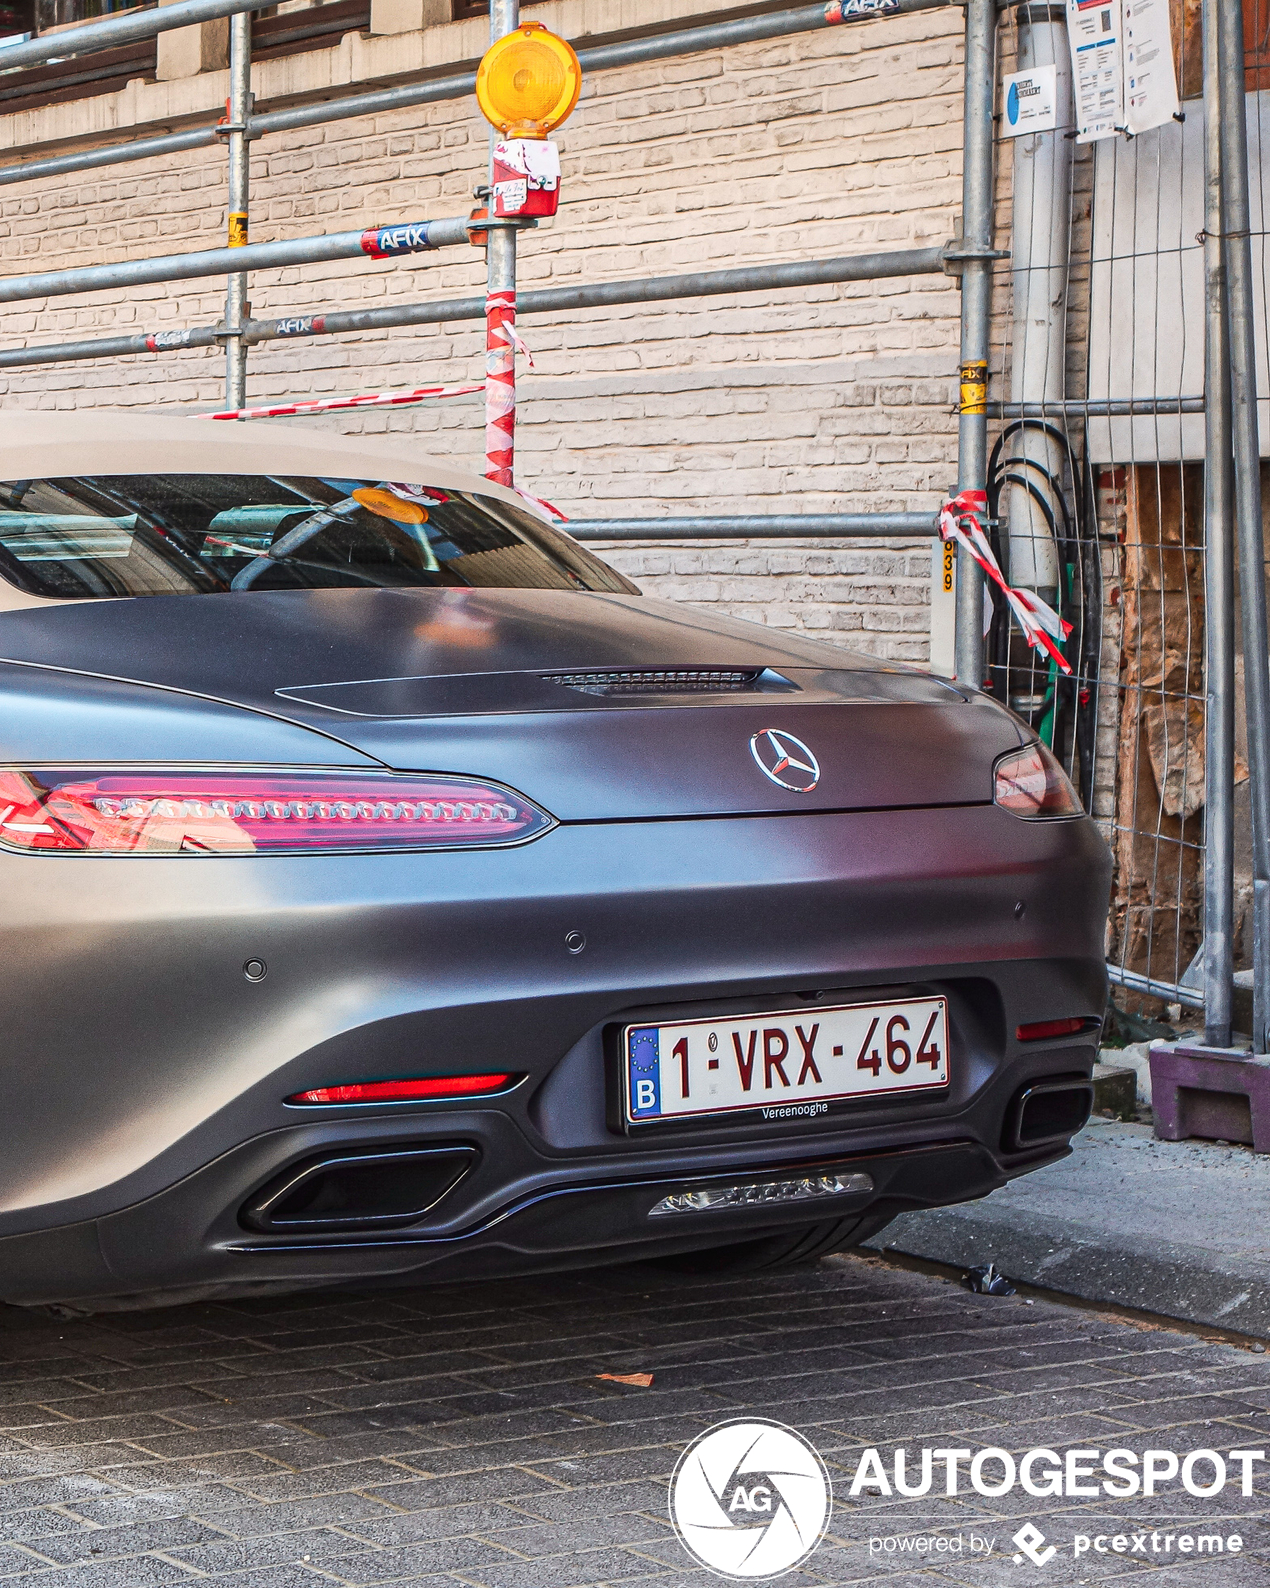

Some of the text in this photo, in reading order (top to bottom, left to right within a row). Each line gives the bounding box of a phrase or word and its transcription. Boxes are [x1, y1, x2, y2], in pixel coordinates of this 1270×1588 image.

[381, 227, 426, 249] AFIX
[277, 317, 310, 333] AFIX
[961, 369, 980, 378] FIX
[636, 1079, 656, 1109] B
[762, 1102, 829, 1120] Vereenooghe
